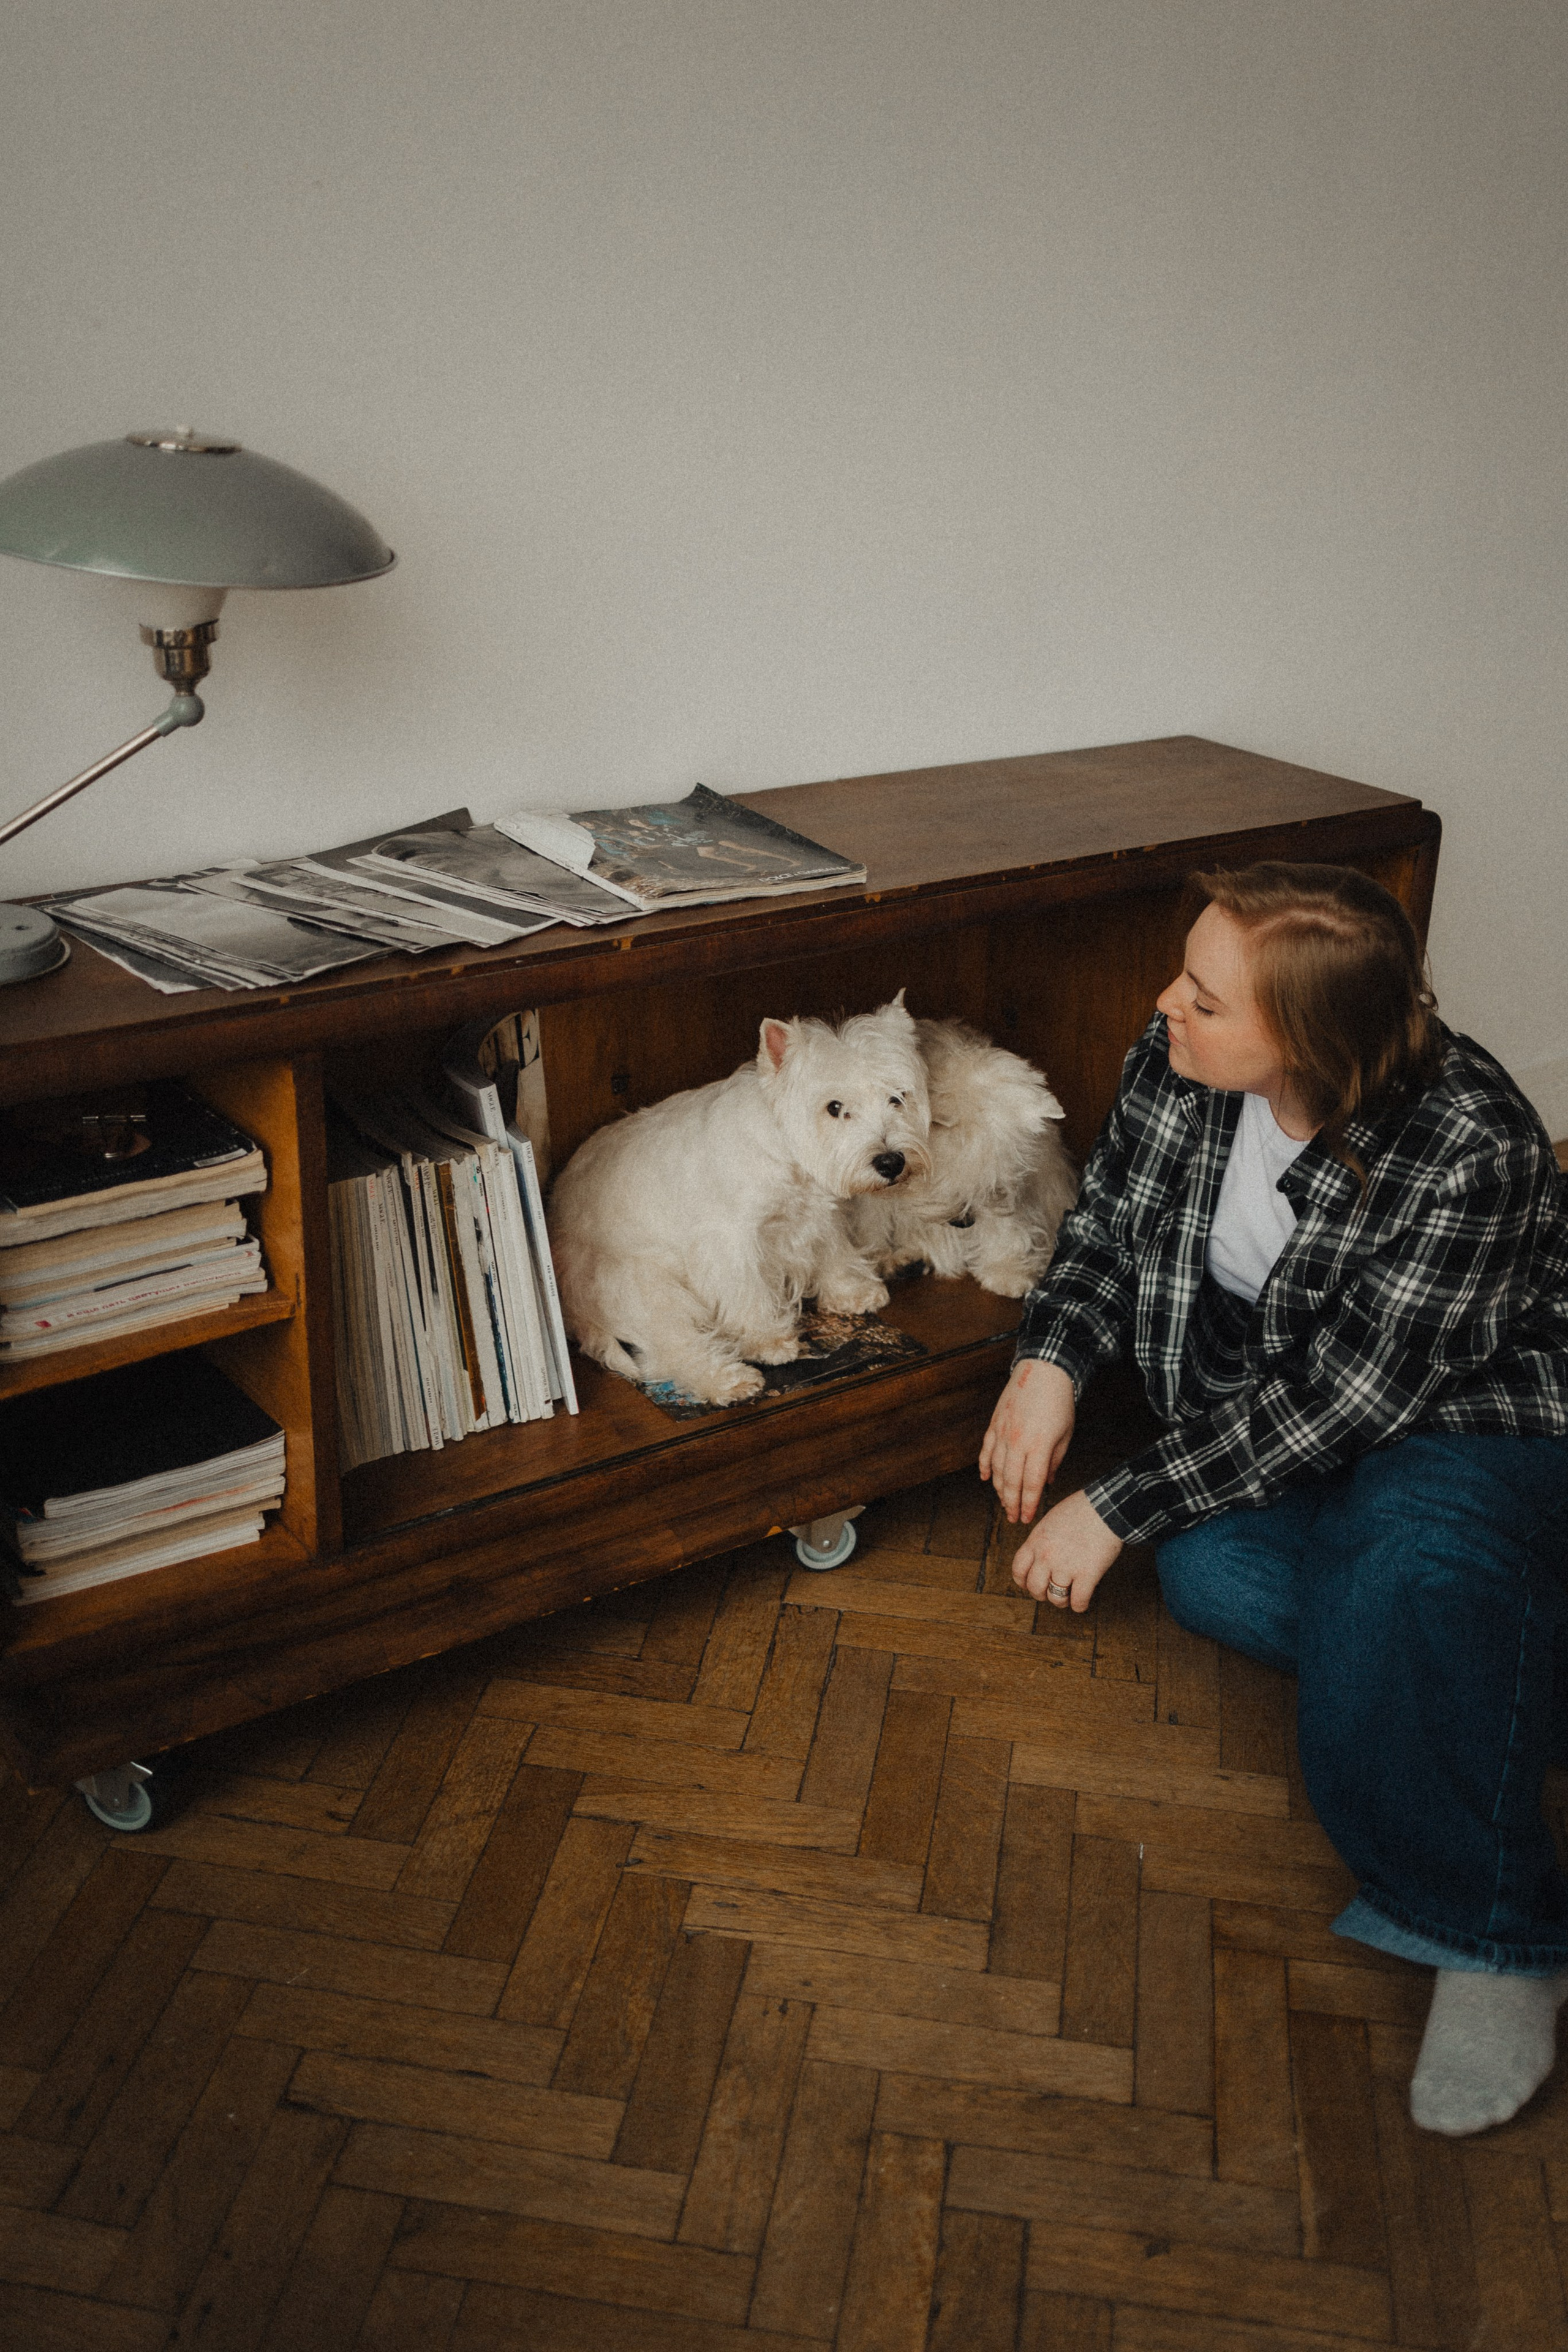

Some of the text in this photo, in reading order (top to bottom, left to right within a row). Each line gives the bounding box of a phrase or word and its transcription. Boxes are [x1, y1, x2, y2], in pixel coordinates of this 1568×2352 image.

[758, 873, 794, 882] DOLCE
[797, 866, 850, 875] GABBANA
[487, 1091, 496, 1112] VOGUE
